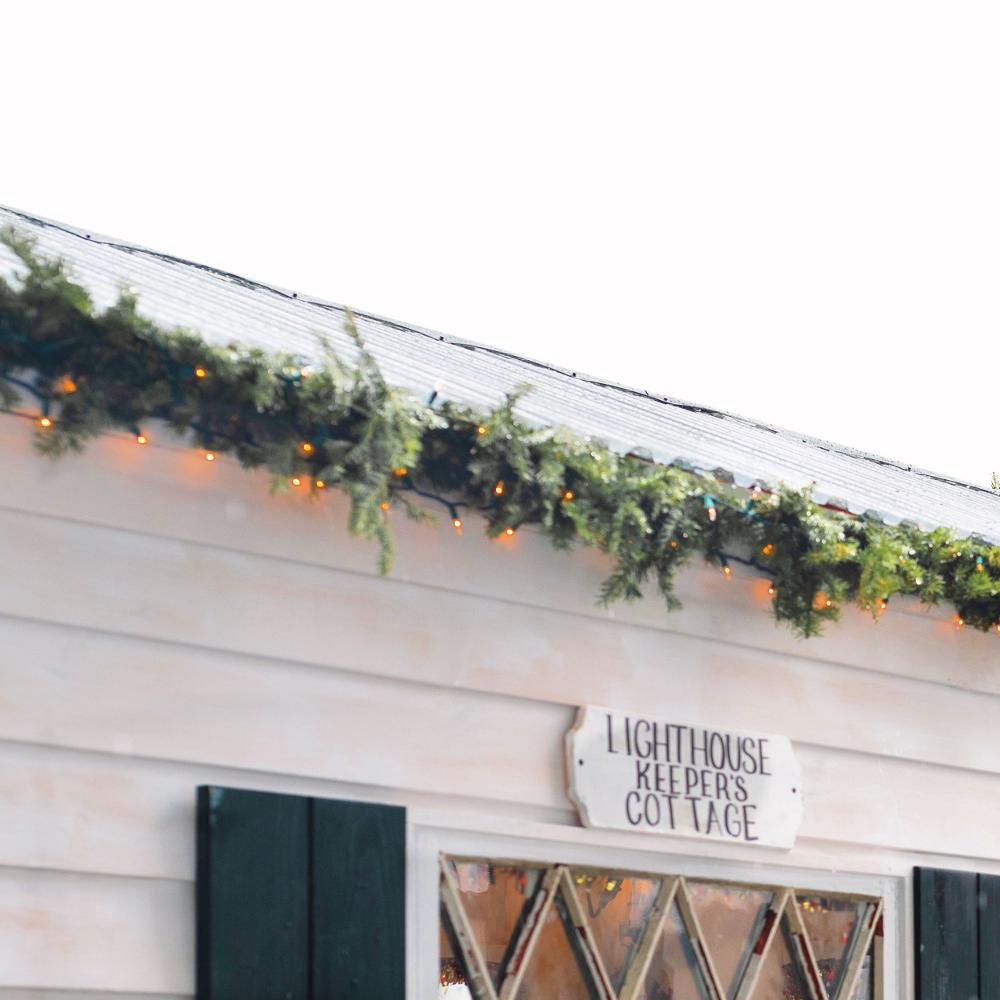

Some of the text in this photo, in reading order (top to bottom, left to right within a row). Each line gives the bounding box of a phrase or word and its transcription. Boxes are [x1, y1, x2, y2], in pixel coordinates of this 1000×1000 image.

[606, 714, 772, 776] LIGHTHOUSE
[636, 760, 748, 802] KEEPER'S
[626, 790, 759, 841] COTTAGE
